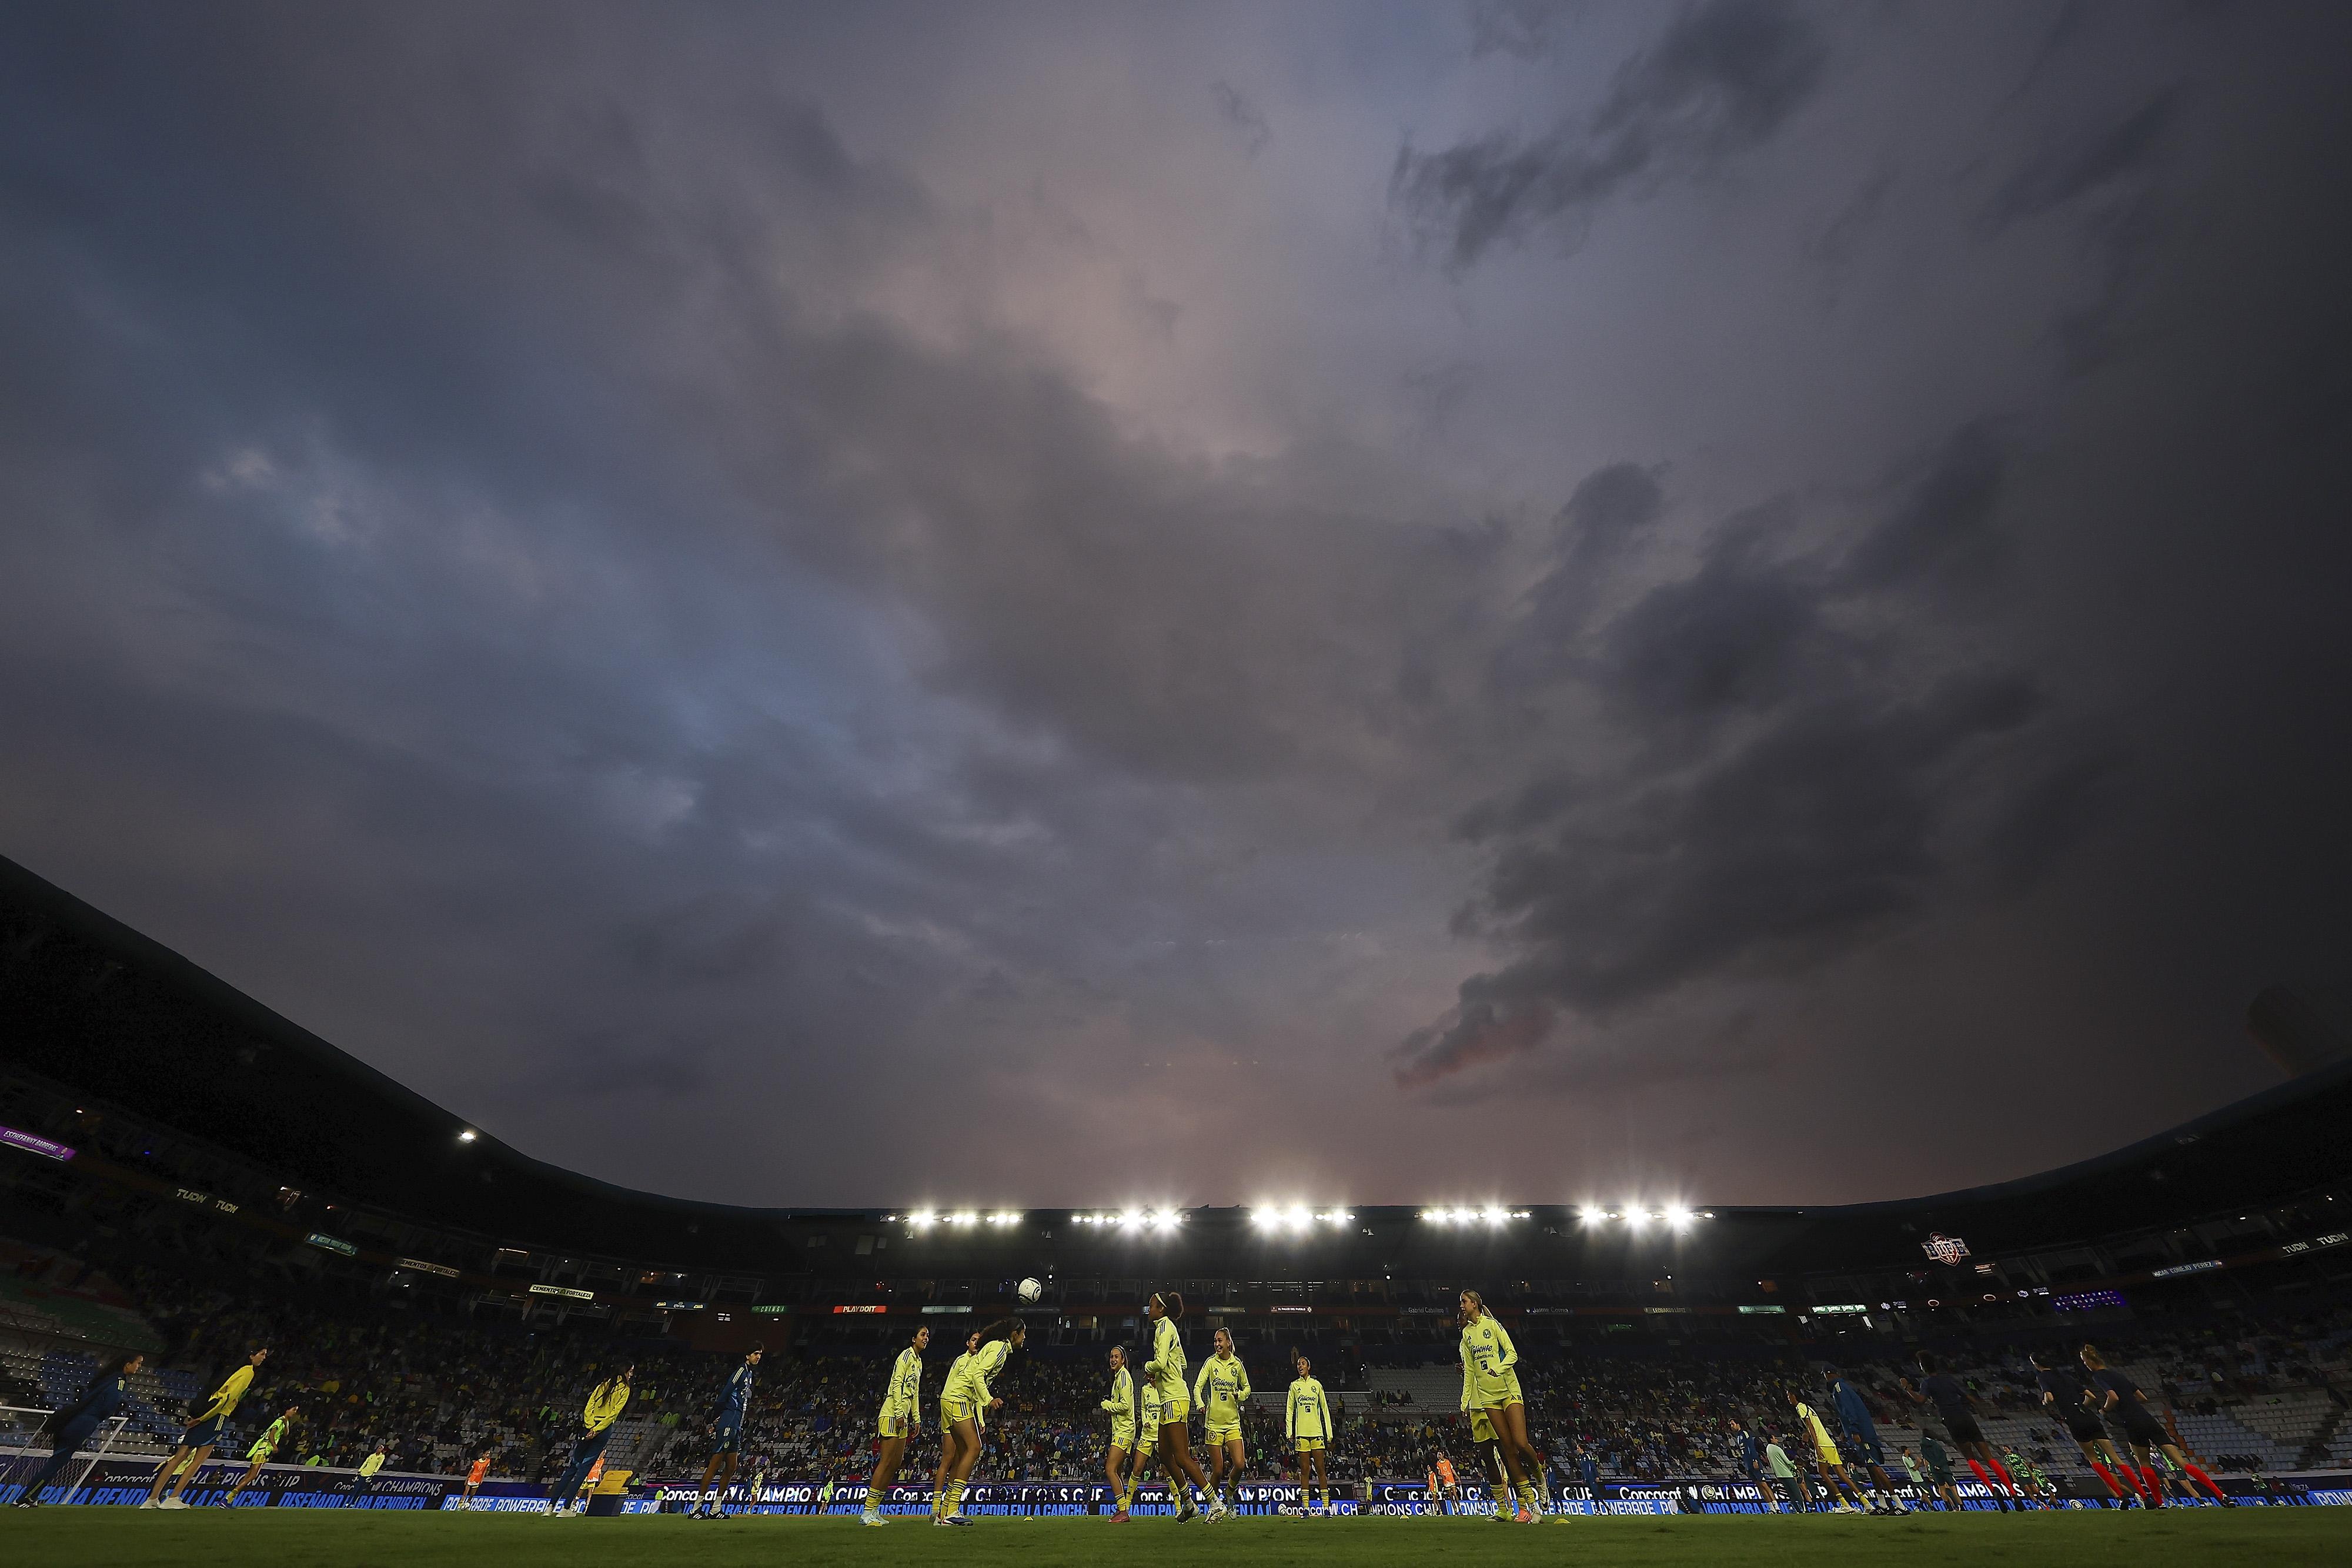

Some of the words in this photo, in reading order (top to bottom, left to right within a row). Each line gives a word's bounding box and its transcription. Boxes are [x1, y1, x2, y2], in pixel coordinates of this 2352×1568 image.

[176, 1188, 207, 1203] TUDN
[216, 1200, 239, 1213] TUDN
[2282, 1242, 2310, 1253] TUDN
[2316, 1233, 2349, 1245] TUDN
[532, 1286, 559, 1294] CEMENTOS
[1212, 1377, 1235, 1387] Caliente
[1298, 1395, 1315, 1403] Caliente
[104, 1471, 158, 1483] oncacaf
[382, 1480, 443, 1496] CHAMPIONS
[663, 1486, 719, 1501] Concaaf
[1619, 1486, 1682, 1500] Concacaf
[278, 1489, 345, 1509] DISEÑADO
